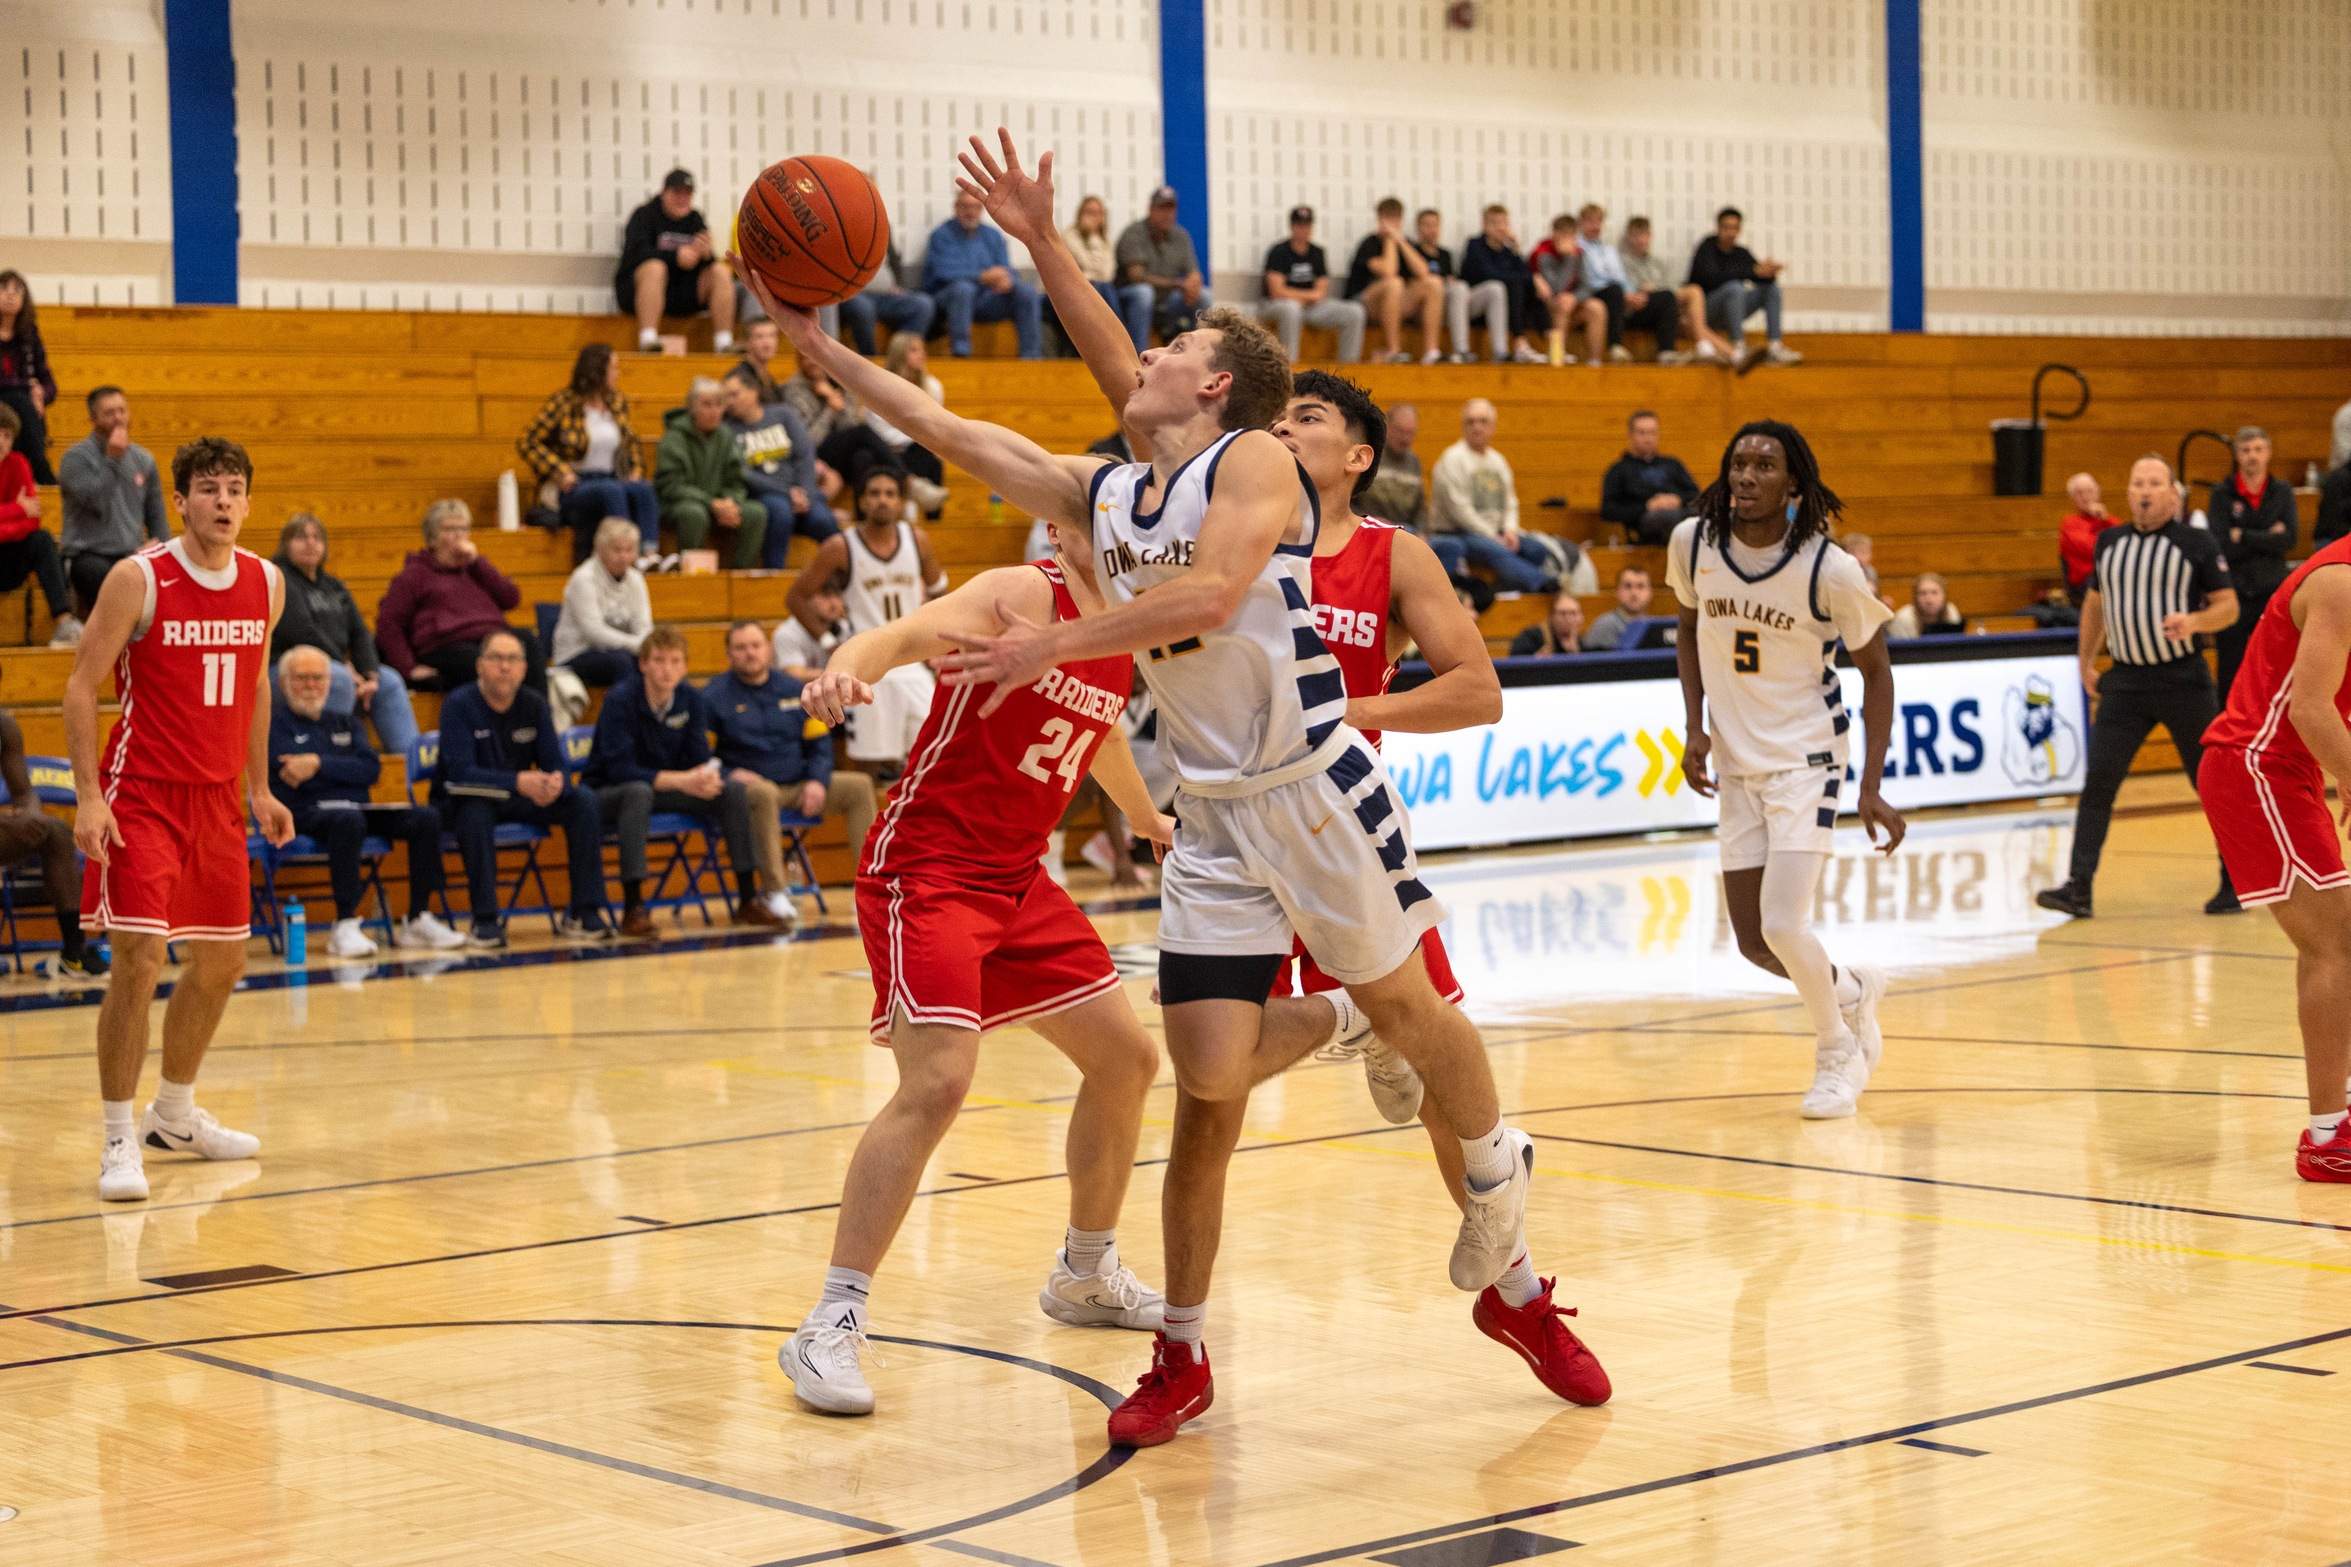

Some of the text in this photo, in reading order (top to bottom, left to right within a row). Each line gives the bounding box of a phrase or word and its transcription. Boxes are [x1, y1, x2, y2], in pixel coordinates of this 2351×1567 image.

[761, 164, 829, 243] PALDING
[1103, 539, 1195, 578] OWA LAKE
[162, 619, 266, 647] RAIDERS
[1309, 603, 1379, 648] ERS
[1743, 599, 1796, 632] LAKES
[1734, 629, 1760, 674] 5
[202, 652, 237, 707] 11
[1031, 666, 1125, 726] RAIDERS
[1016, 716, 1097, 793] 24
[1388, 729, 1627, 809] WA LAKES
